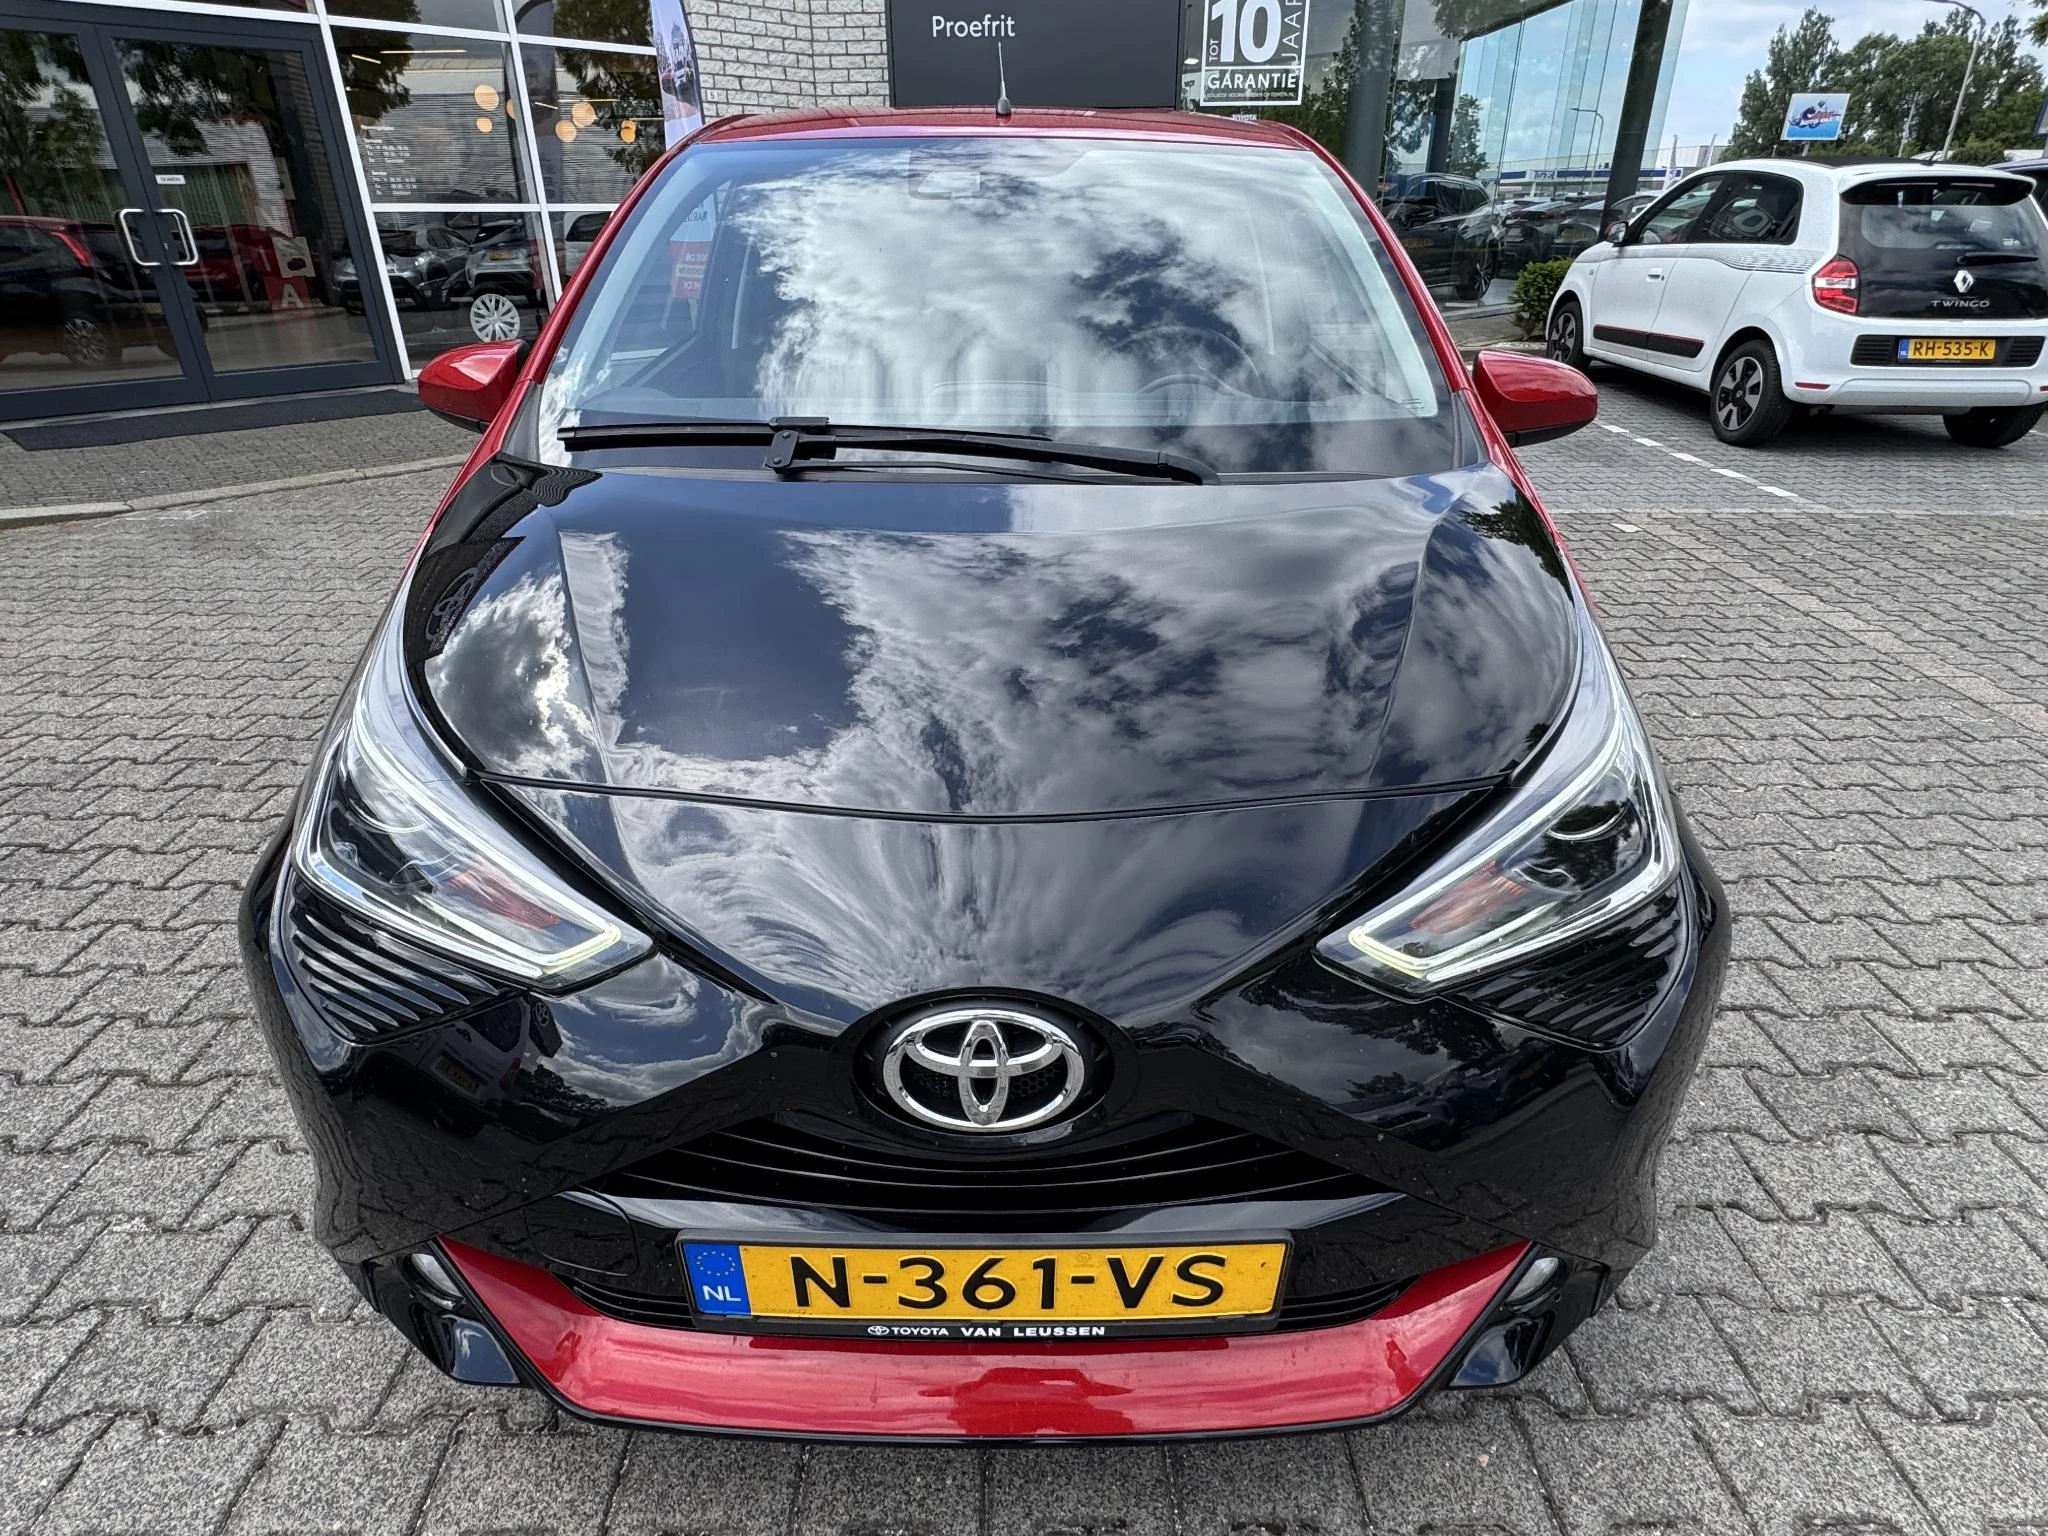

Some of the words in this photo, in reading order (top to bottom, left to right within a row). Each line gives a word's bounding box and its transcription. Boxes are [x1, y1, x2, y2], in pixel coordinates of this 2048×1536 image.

[932, 13, 1016, 38] Proefrit
[1210, 0, 1282, 63] 10
[1208, 38, 1220, 63] TOT
[1206, 72, 1298, 90] GARANTIE
[1930, 300, 1990, 308] TWINGO
[1912, 340, 1990, 357] RH-535-K
[789, 1253, 1228, 1311] N-361-VS
[701, 1284, 742, 1303] NL
[890, 1326, 950, 1336] TOYOTA
[960, 1326, 1001, 1337] VAN
[1013, 1326, 1106, 1337] LEUSSEN
